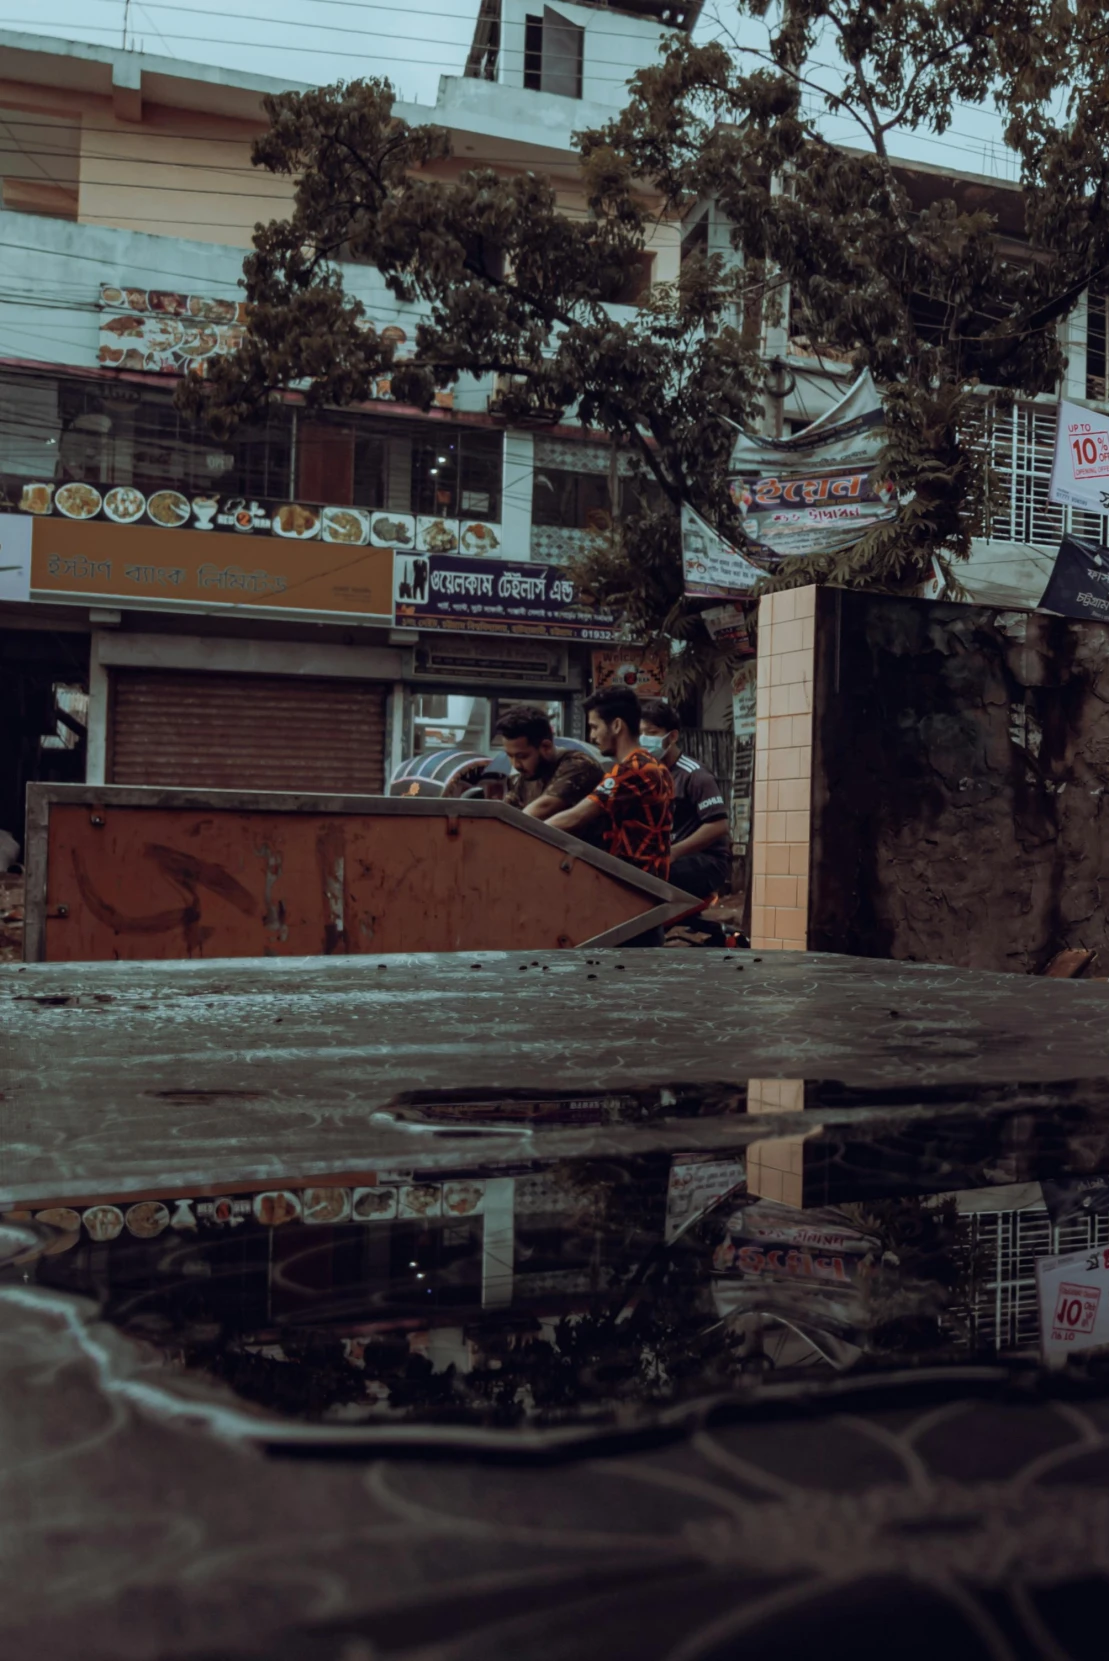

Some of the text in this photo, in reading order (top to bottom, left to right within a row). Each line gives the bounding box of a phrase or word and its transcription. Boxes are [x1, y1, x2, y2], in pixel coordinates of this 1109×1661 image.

[1068, 424, 1091, 433] UP TO
[1072, 437, 1097, 465] 10
[125, 564, 187, 586] ব্যাংক
[197, 561, 288, 594] লিমিটেড
[430, 569, 494, 598] ওয়েলকাম
[549, 580, 574, 603] এন্ড
[1076, 592, 1109, 611] চট্টগ্রাম
